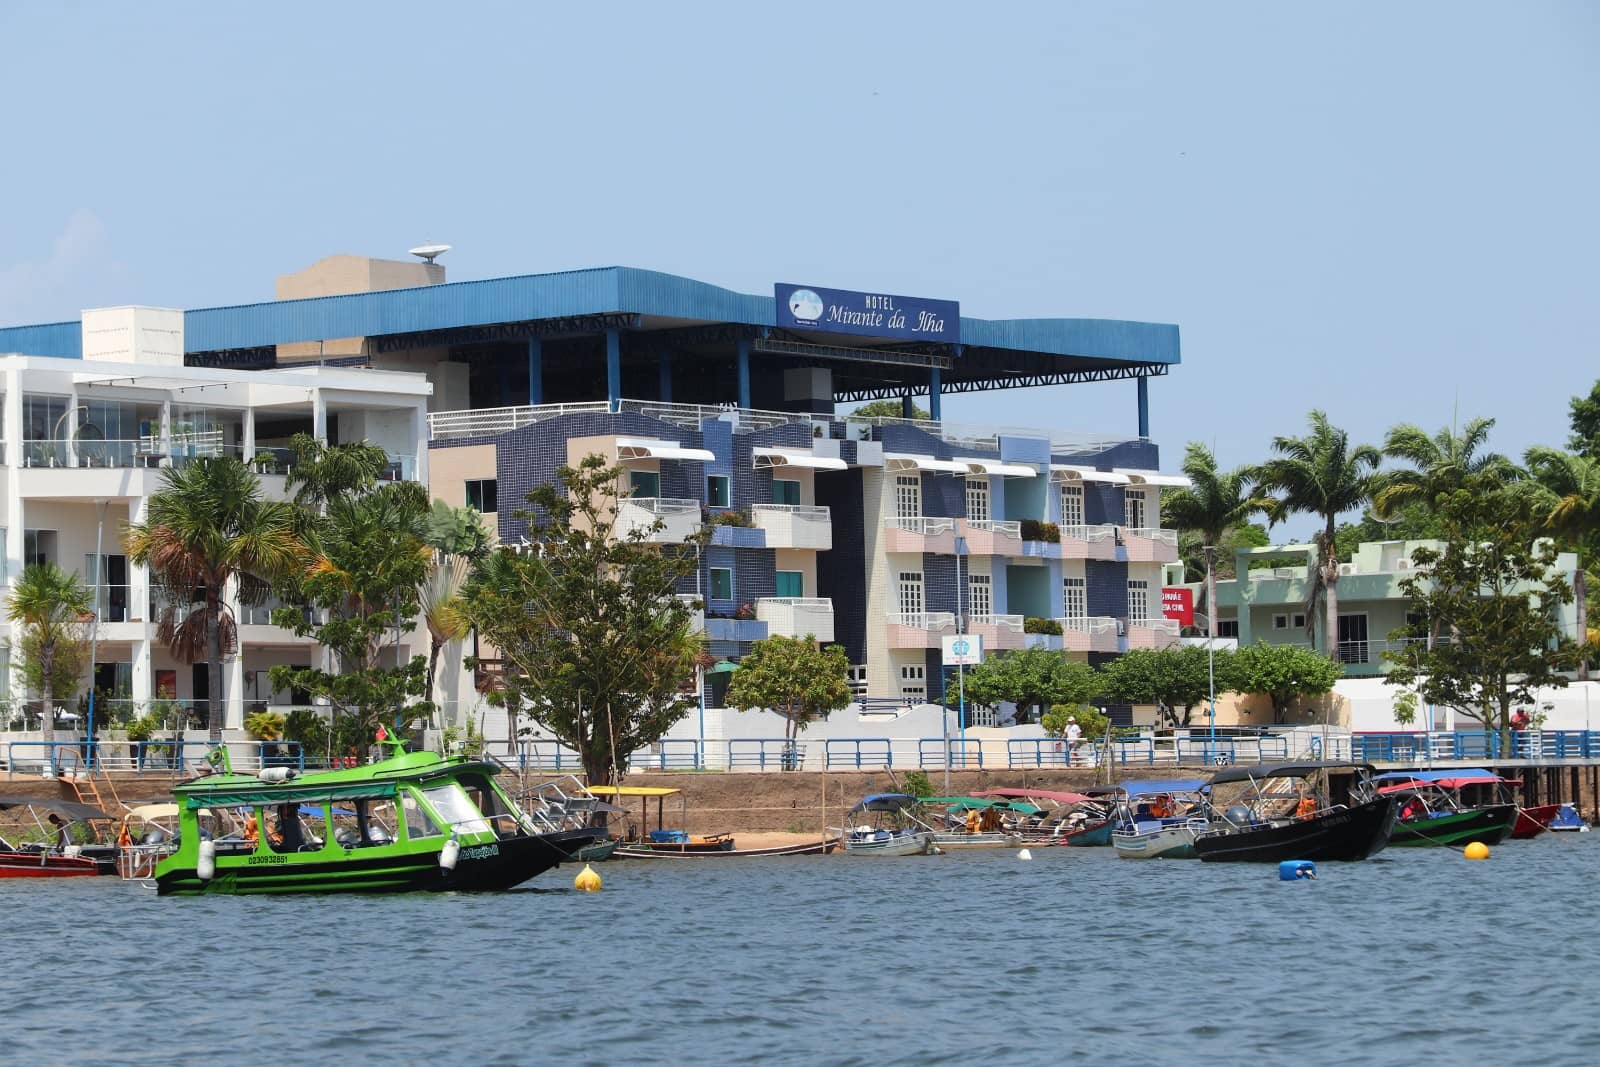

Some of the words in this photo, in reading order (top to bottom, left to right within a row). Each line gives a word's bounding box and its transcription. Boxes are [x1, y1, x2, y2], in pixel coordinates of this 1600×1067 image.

[866, 296, 893, 310] HOTEL
[827, 305, 882, 327] Mirante
[888, 309, 905, 328] da
[912, 311, 944, 333] Ilha
